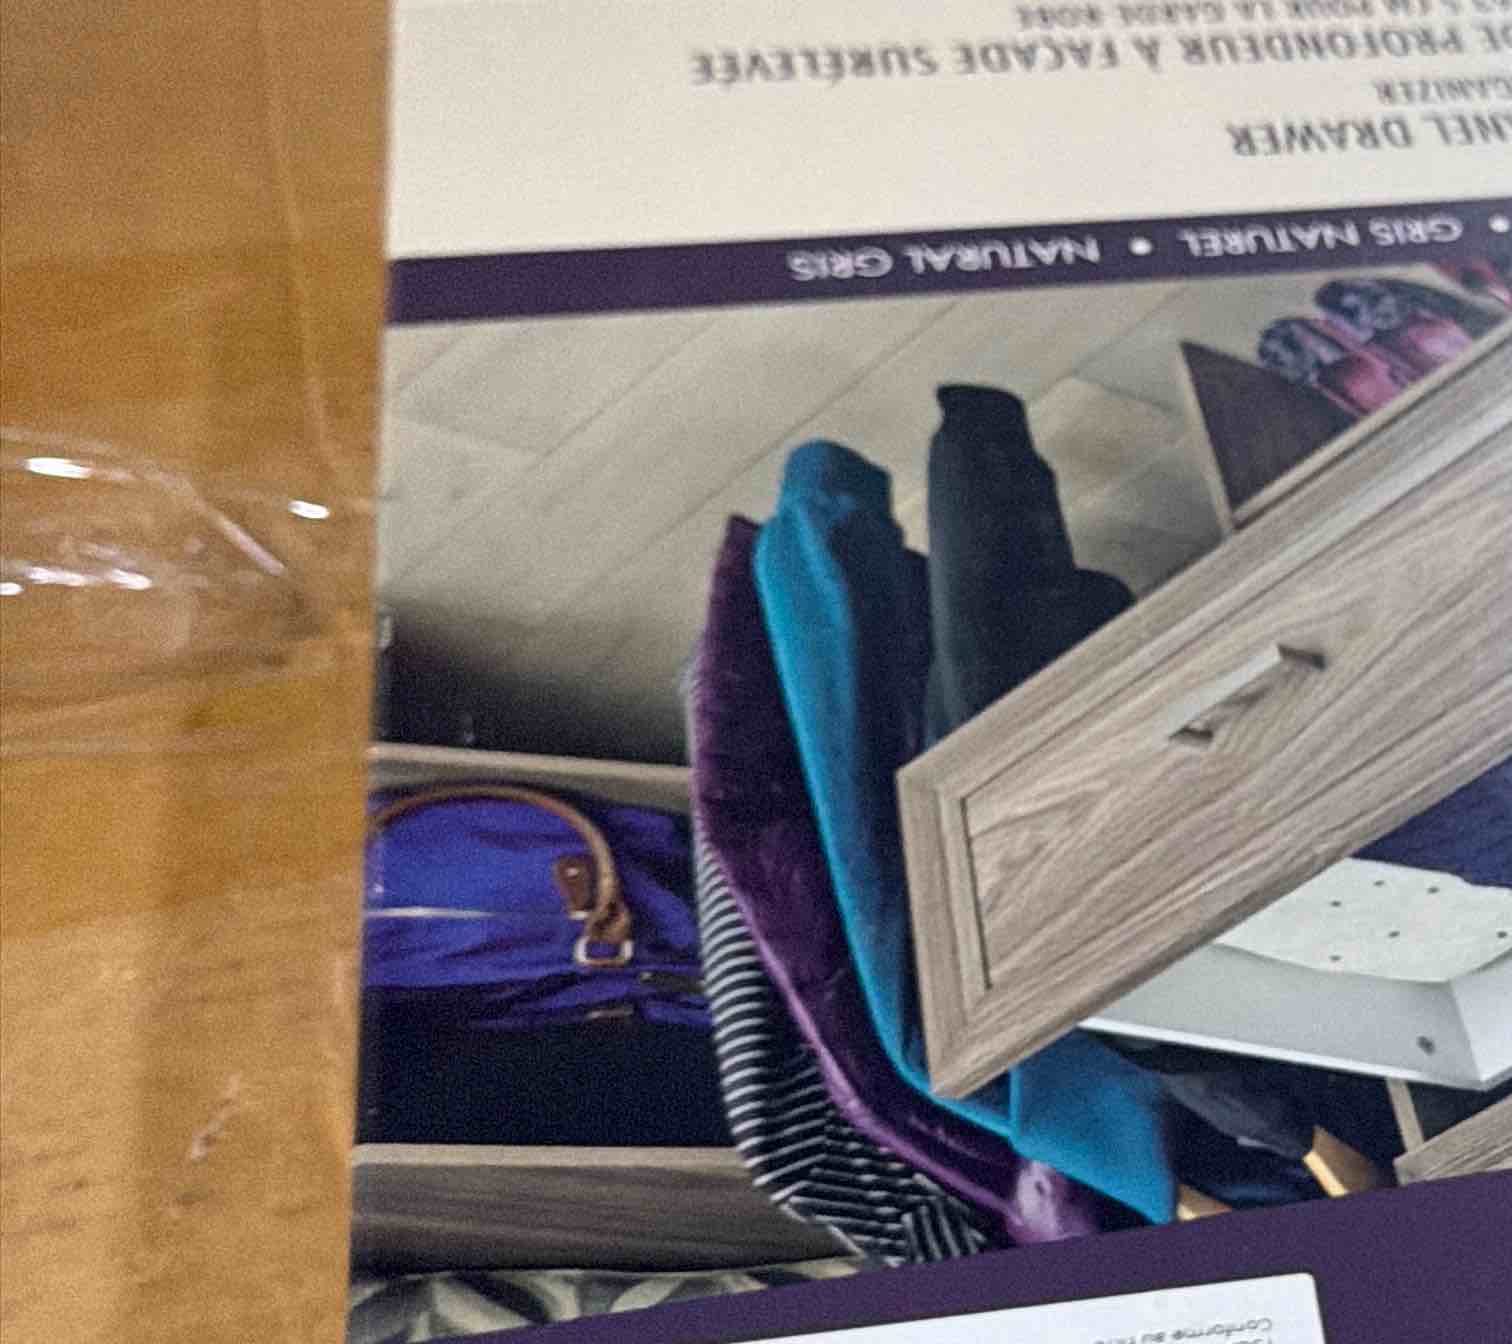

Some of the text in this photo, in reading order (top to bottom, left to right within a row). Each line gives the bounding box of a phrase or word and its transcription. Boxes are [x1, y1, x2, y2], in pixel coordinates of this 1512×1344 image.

[954, 33, 1119, 77] FAÇADE
[1177, 27, 1463, 67] PROFONDEUR
[1226, 117, 1414, 159] DRAWER
[1178, 221, 1358, 259] NATUREL
[1369, 214, 1464, 248] GRIS
[785, 233, 1101, 282] NATURAL GRIS
